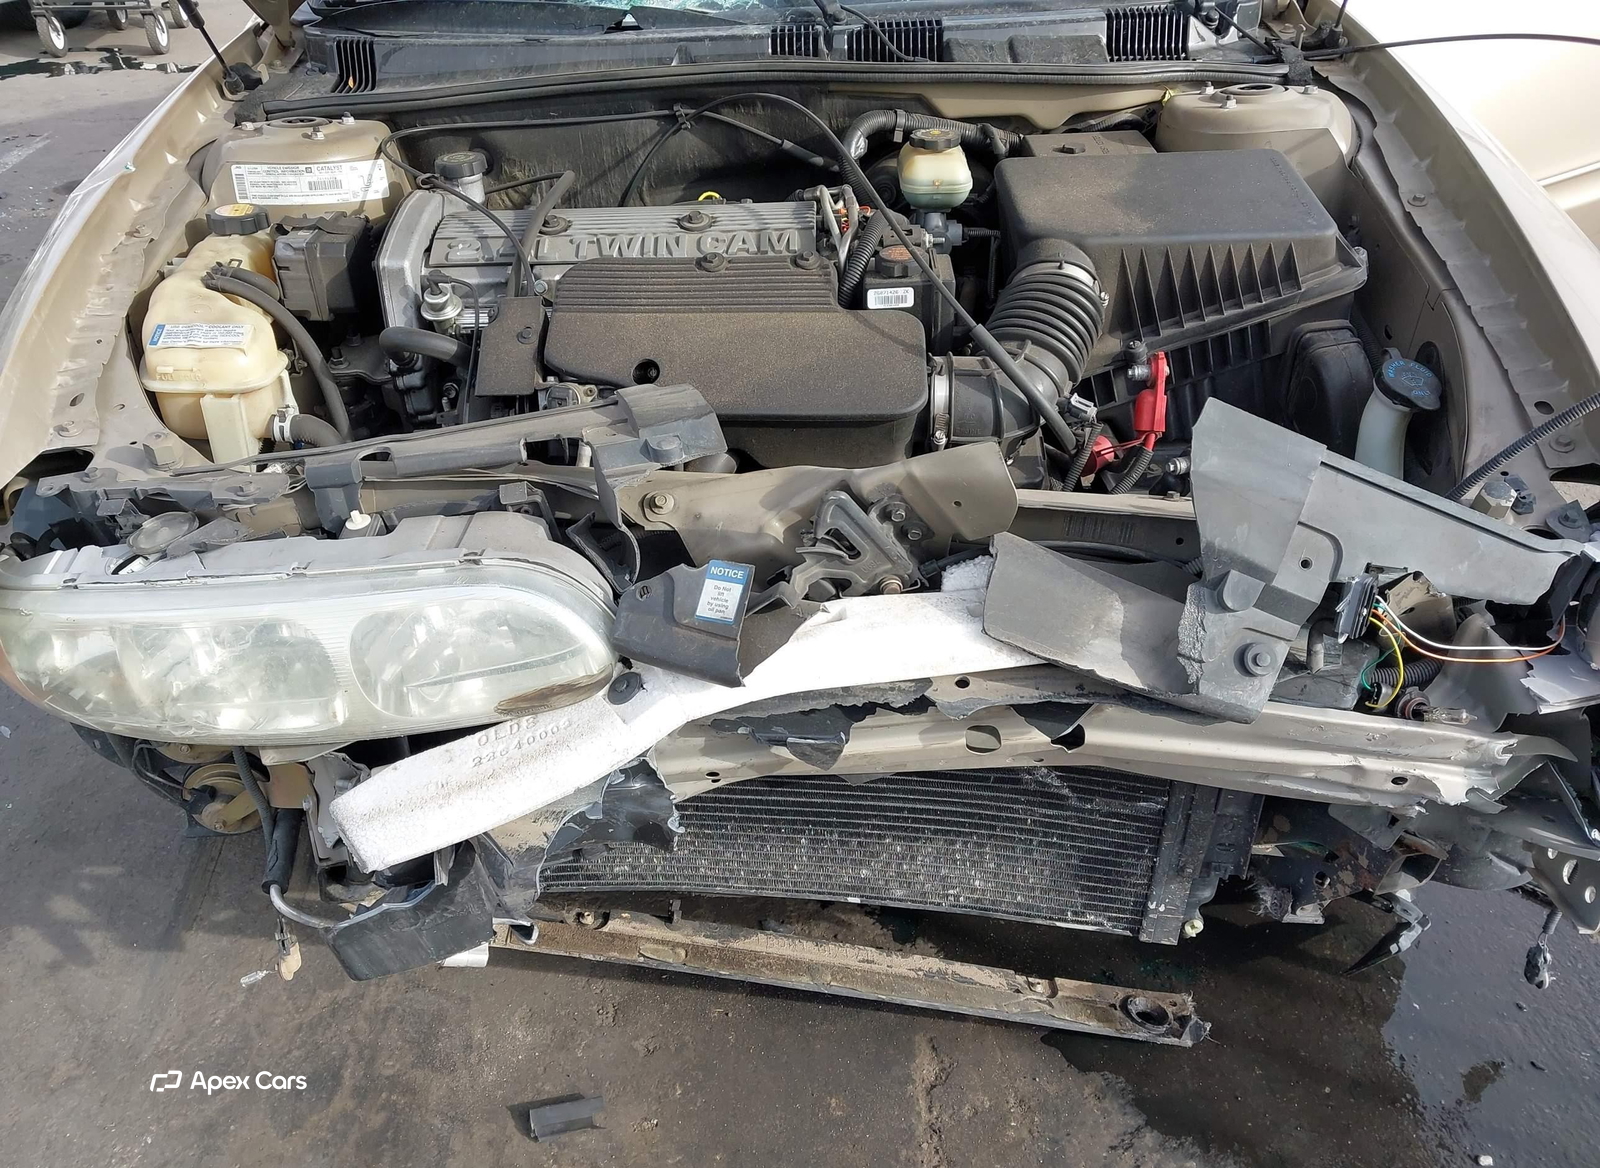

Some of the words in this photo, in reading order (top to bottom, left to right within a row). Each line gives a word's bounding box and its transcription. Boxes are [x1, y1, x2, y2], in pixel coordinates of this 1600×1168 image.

[572, 233, 688, 258] TWIN
[700, 230, 800, 255] CAM
[1410, 362, 1433, 378] FLUID
[710, 566, 745, 579] NOTICE
[477, 715, 538, 747] OLDS
